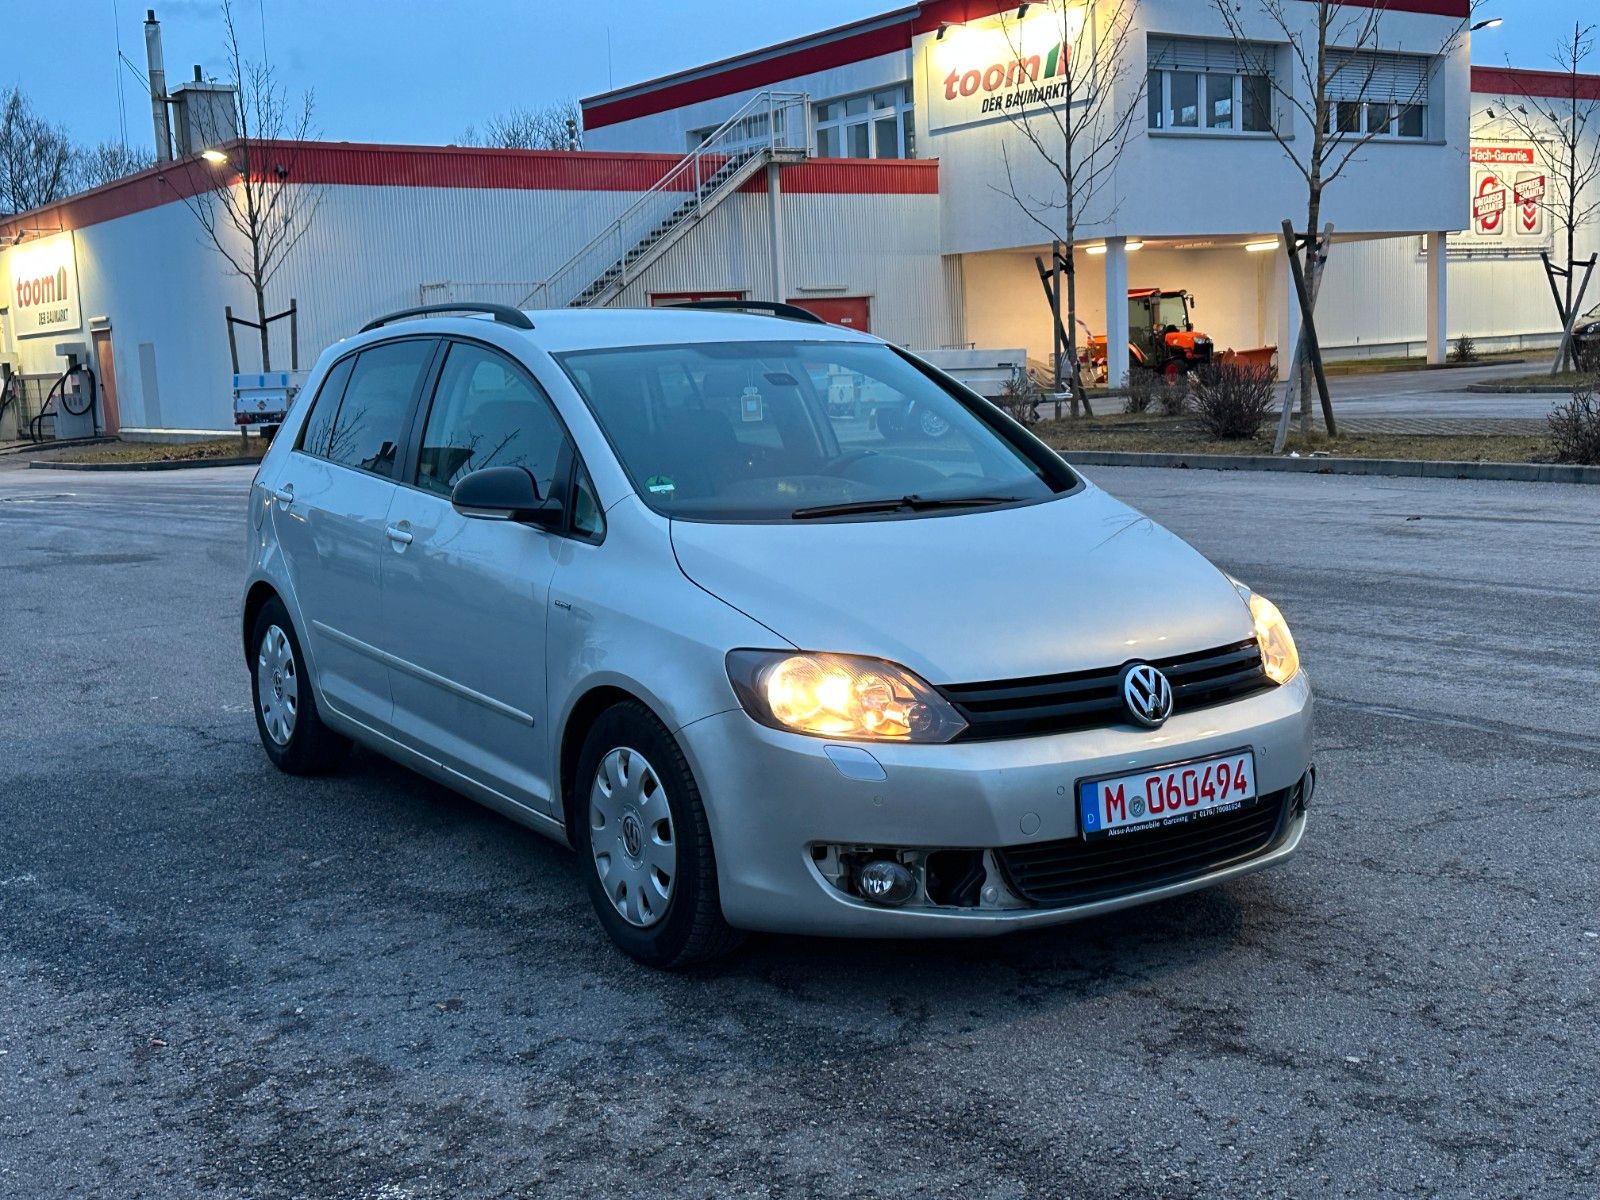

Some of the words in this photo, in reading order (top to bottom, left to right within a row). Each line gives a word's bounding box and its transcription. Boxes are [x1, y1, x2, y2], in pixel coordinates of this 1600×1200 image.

[943, 54, 1041, 101] toom
[981, 95, 1003, 113] DER
[1005, 82, 1068, 109] BAUMARKT
[16, 274, 56, 309] toom
[1104, 783, 1127, 823] M
[1145, 758, 1247, 814] 060494
[1087, 812, 1095, 825] D
